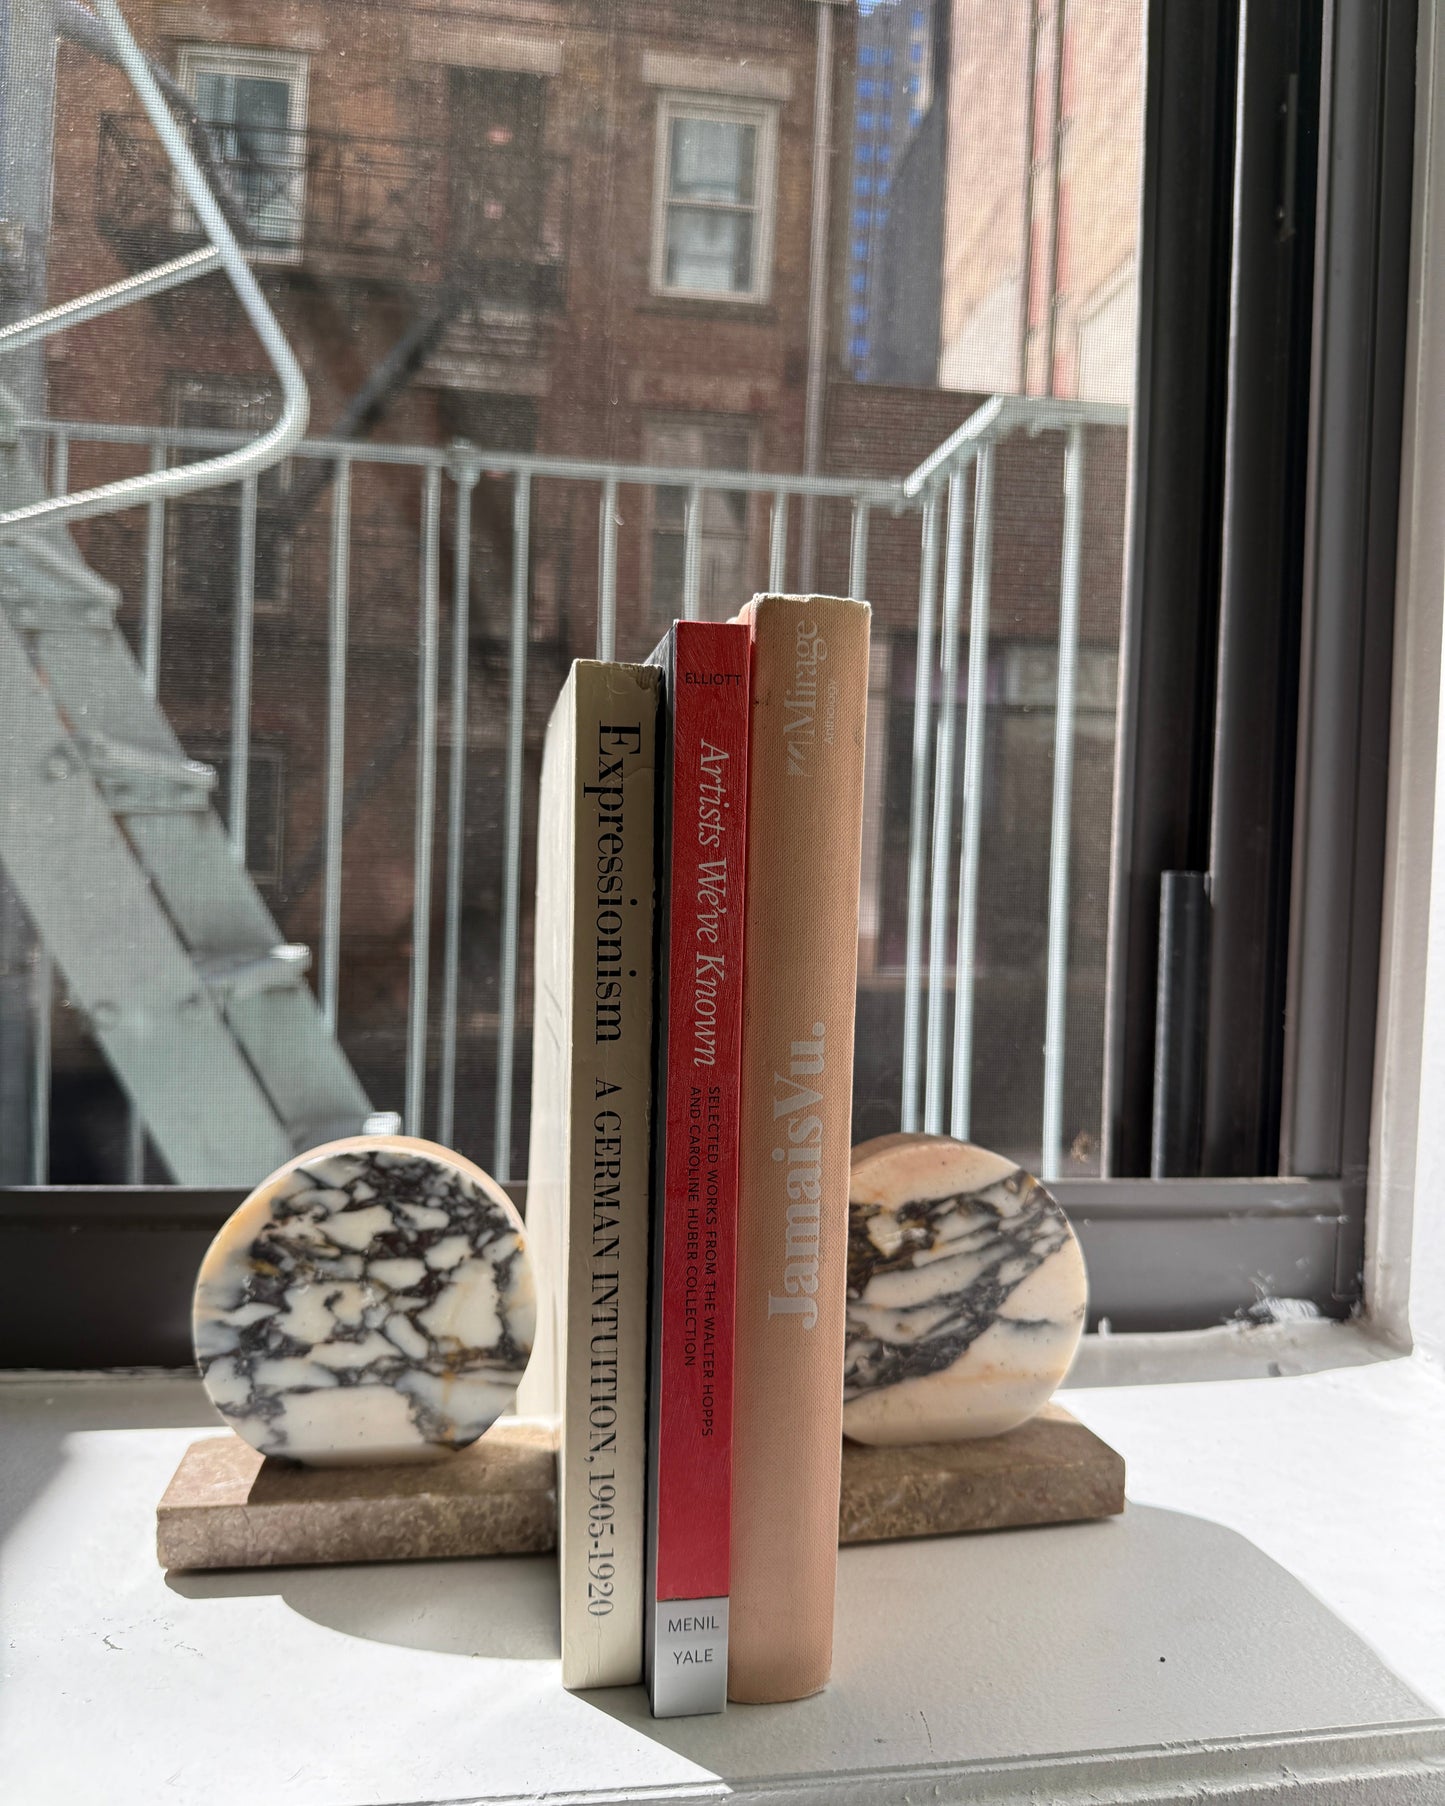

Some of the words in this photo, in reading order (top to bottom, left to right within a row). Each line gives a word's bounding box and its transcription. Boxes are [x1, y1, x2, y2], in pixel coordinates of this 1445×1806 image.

[685, 672, 742, 686] ELLIOTT
[782, 620, 828, 736] Mirage
[824, 679, 839, 746] Anthology
[698, 738, 730, 848] Artists
[583, 720, 641, 1044] Expressionism
[696, 858, 727, 943] We've
[694, 951, 725, 1067] Known
[595, 1077, 622, 1100] A
[689, 1087, 700, 1120] AND
[707, 1086, 720, 1164] SELECTED
[592, 1110, 622, 1259] GERMAN
[687, 1124, 700, 1202] CAROLINE
[706, 1169, 719, 1225] WORKS
[686, 1208, 699, 1261] HUBER
[704, 1230, 717, 1275] FROM
[684, 1265, 698, 1367] COLLECTION
[703, 1279, 716, 1310] THE
[584, 1272, 620, 1462] INTUITION,
[702, 1317, 716, 1379] WALTER
[701, 1384, 714, 1437] HOPPS
[587, 1469, 616, 1617] 1905-1920
[668, 1616, 719, 1632] MENIL
[673, 1649, 713, 1665] YALE
